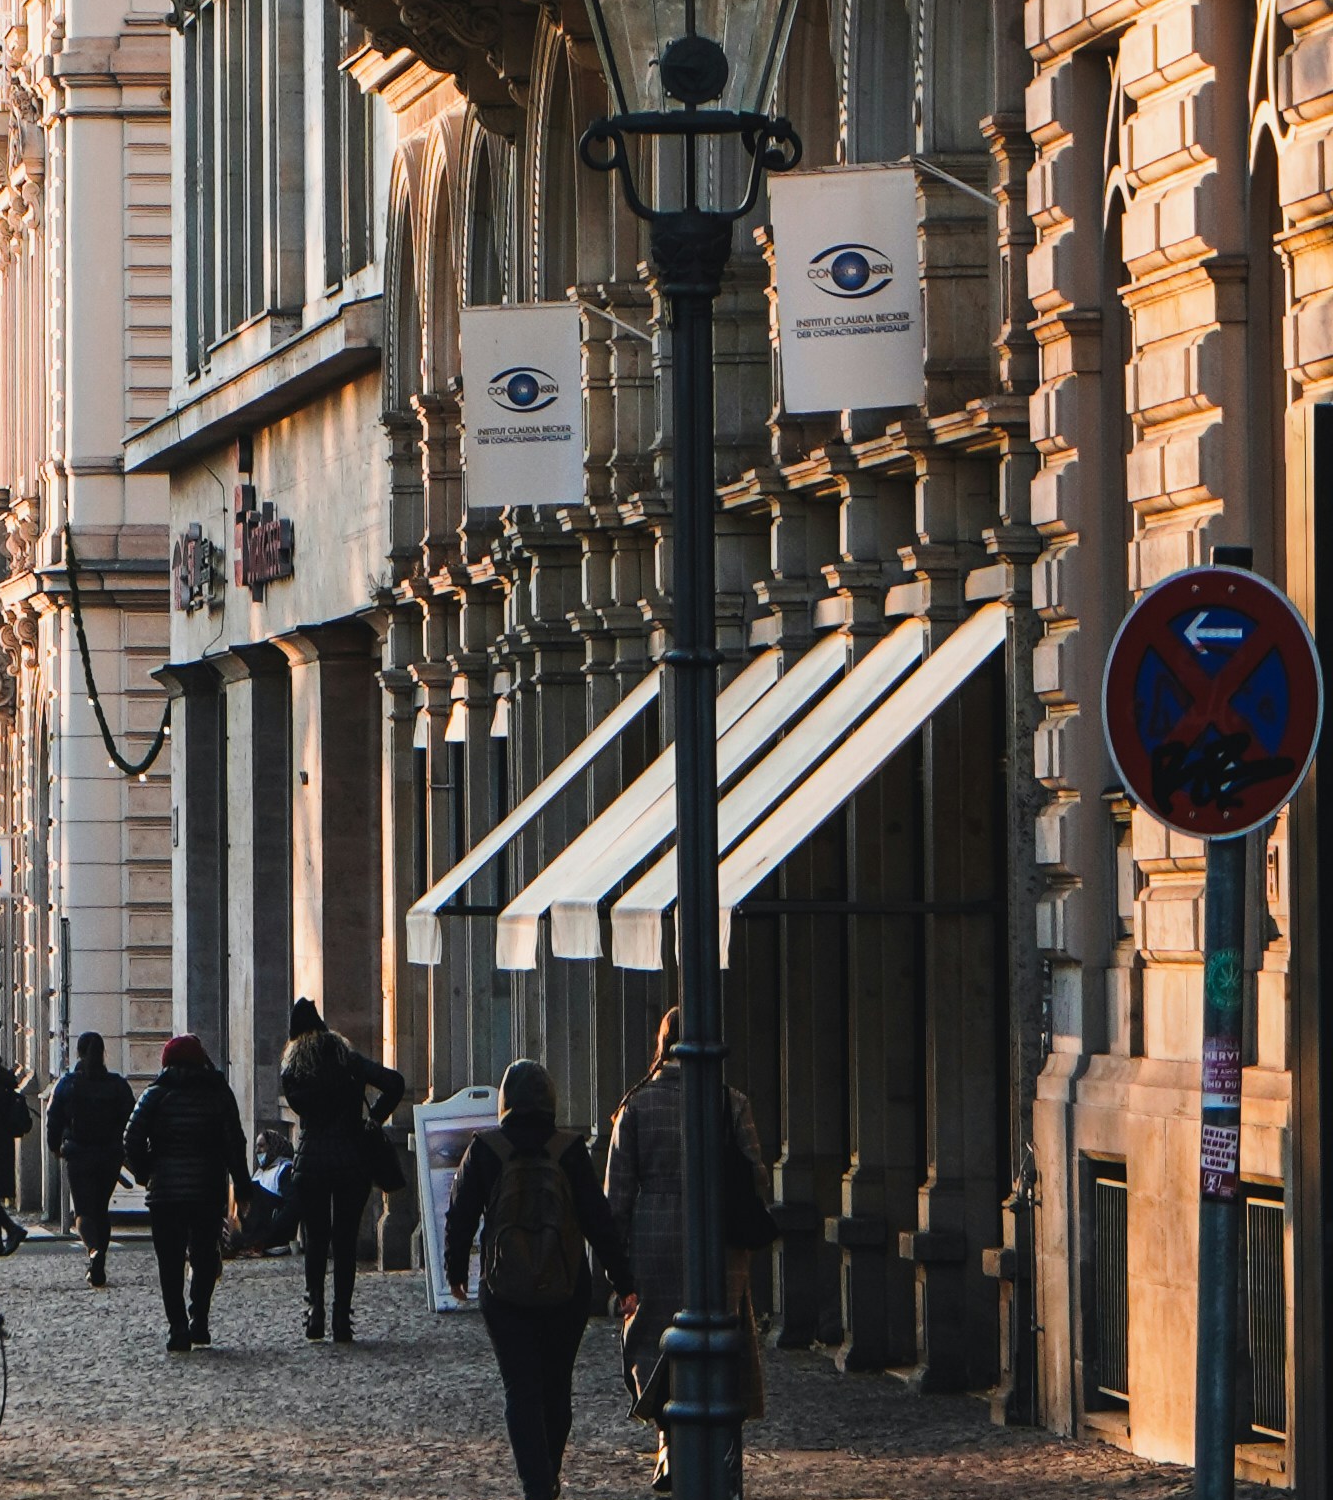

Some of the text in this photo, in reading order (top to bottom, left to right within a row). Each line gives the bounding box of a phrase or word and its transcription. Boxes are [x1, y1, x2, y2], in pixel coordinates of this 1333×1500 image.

[796, 312, 910, 328] INSTITUT CLAUDIA BECKER
[507, 425, 541, 435] CLAUDIA
